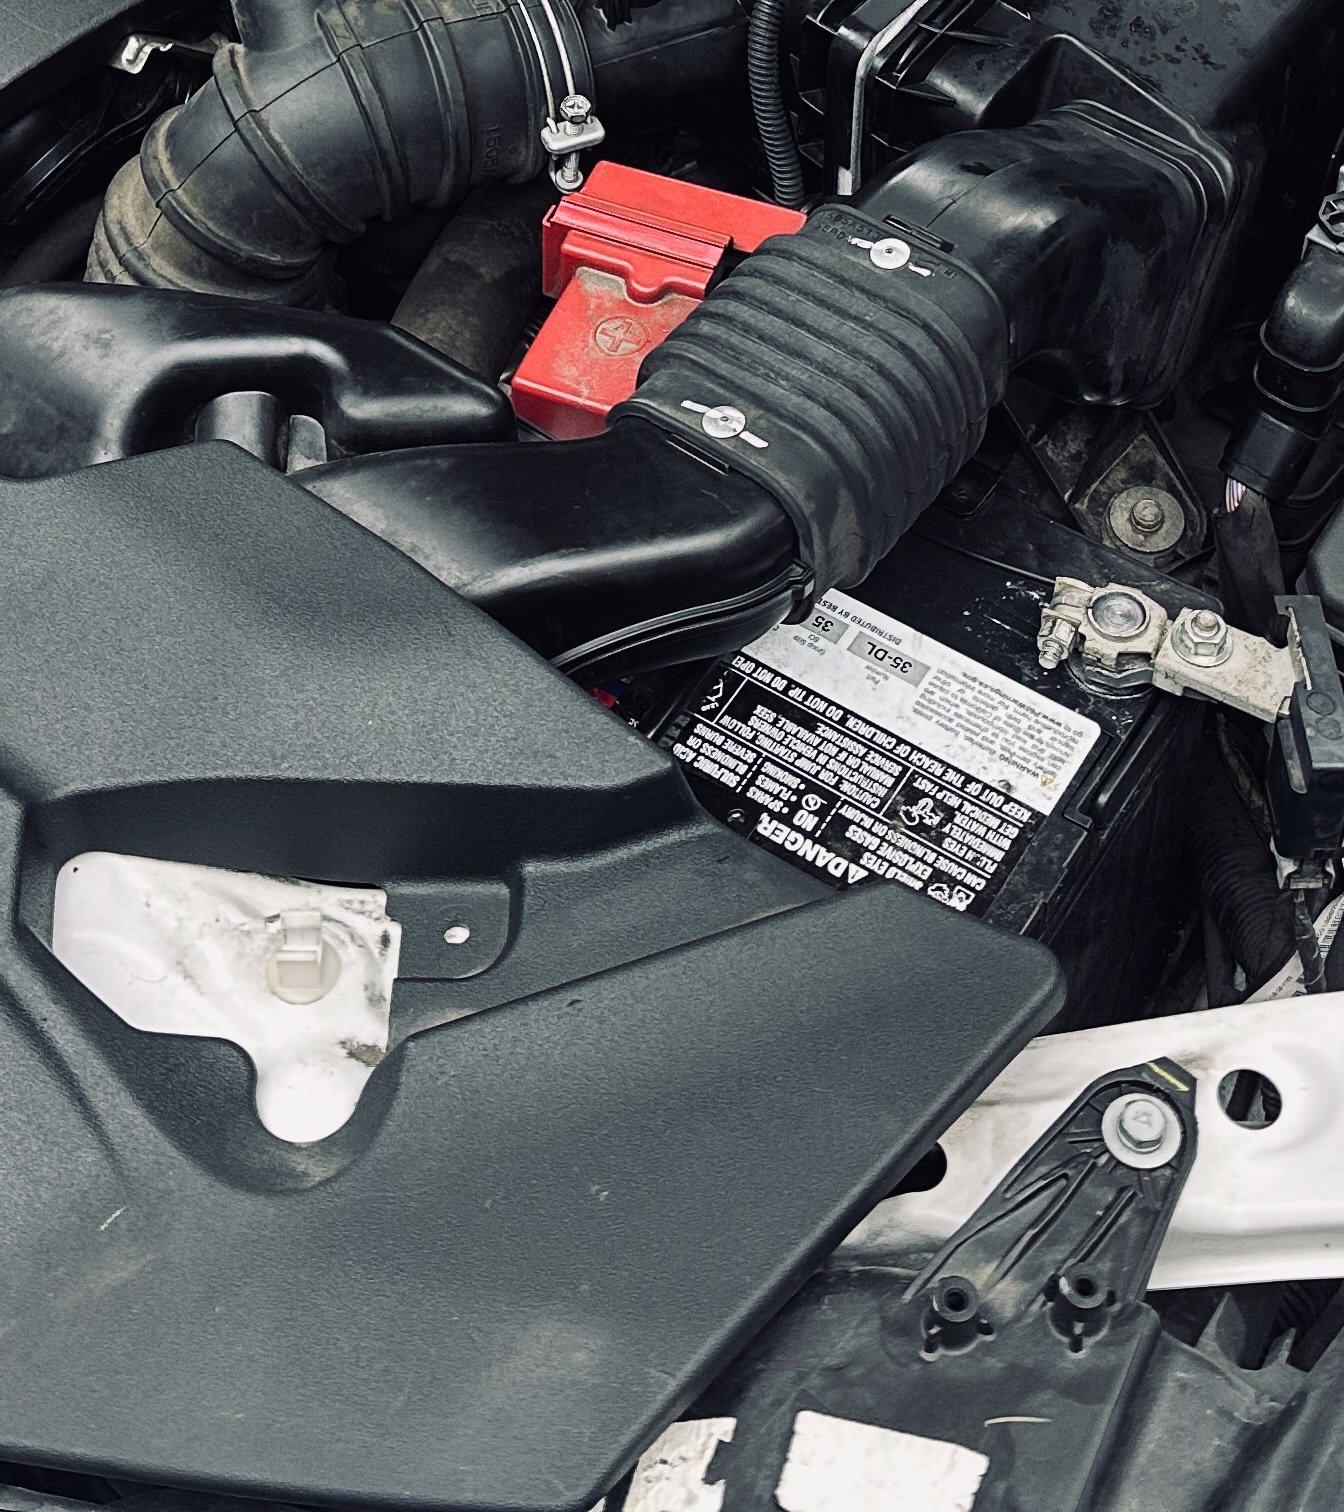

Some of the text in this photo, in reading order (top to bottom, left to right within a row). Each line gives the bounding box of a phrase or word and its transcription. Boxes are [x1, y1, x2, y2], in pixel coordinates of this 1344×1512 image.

[811, 615, 834, 633] 35
[837, 608, 851, 619] BY
[850, 615, 902, 646] DISTRIBUTED
[731, 655, 756, 674] OPE
[867, 641, 913, 674] 35-DL
[751, 666, 775, 684] NOT
[770, 676, 788, 692] DO
[787, 684, 807, 702] TIP.
[803, 694, 829, 713] NOT
[752, 704, 777, 723] SEEK
[825, 705, 844, 722] DO
[718, 714, 757, 740] FOLLOW
[693, 723, 757, 764] SEVERE BURNS
[817, 740, 840, 757] NOT
[892, 743, 912, 758] OF
[672, 742, 741, 788] SULFURIC ACID
[686, 735, 749, 776] BLINDNESS OR
[747, 715, 889, 798] INSTRUCTIONS IN VEHICLE OWNERS
[793, 756, 822, 775] JUMP
[835, 750, 849, 762] IF
[845, 754, 862, 769] OR
[864, 750, 903, 777] SERVICE
[908, 749, 947, 777] REACH
[998, 753, 1040, 779] WARNING
[760, 761, 802, 789] SMOKING
[817, 768, 840, 786] FOR
[858, 760, 896, 788] MANUAL
[941, 768, 966, 788] THE
[754, 774, 793, 801] FLAMES
[963, 781, 984, 796] OF
[978, 788, 1005, 808] OUT
[745, 786, 784, 813] SPARKS
[935, 789, 963, 809] HELP
[792, 809, 819, 832] NO
[960, 800, 1002, 830] MEDICAL
[1001, 801, 1033, 823] KEEP
[940, 822, 1006, 862] IMMEDIATELY
[984, 829, 1012, 851] WITH
[997, 822, 1020, 840] GET
[837, 804, 987, 891] CAN CAUSE BLINDNESS OR INJURY
[844, 824, 934, 881] EXPLOSIVE GASES
[941, 837, 999, 874] FLUH EYES
[859, 851, 890, 876] EYES
